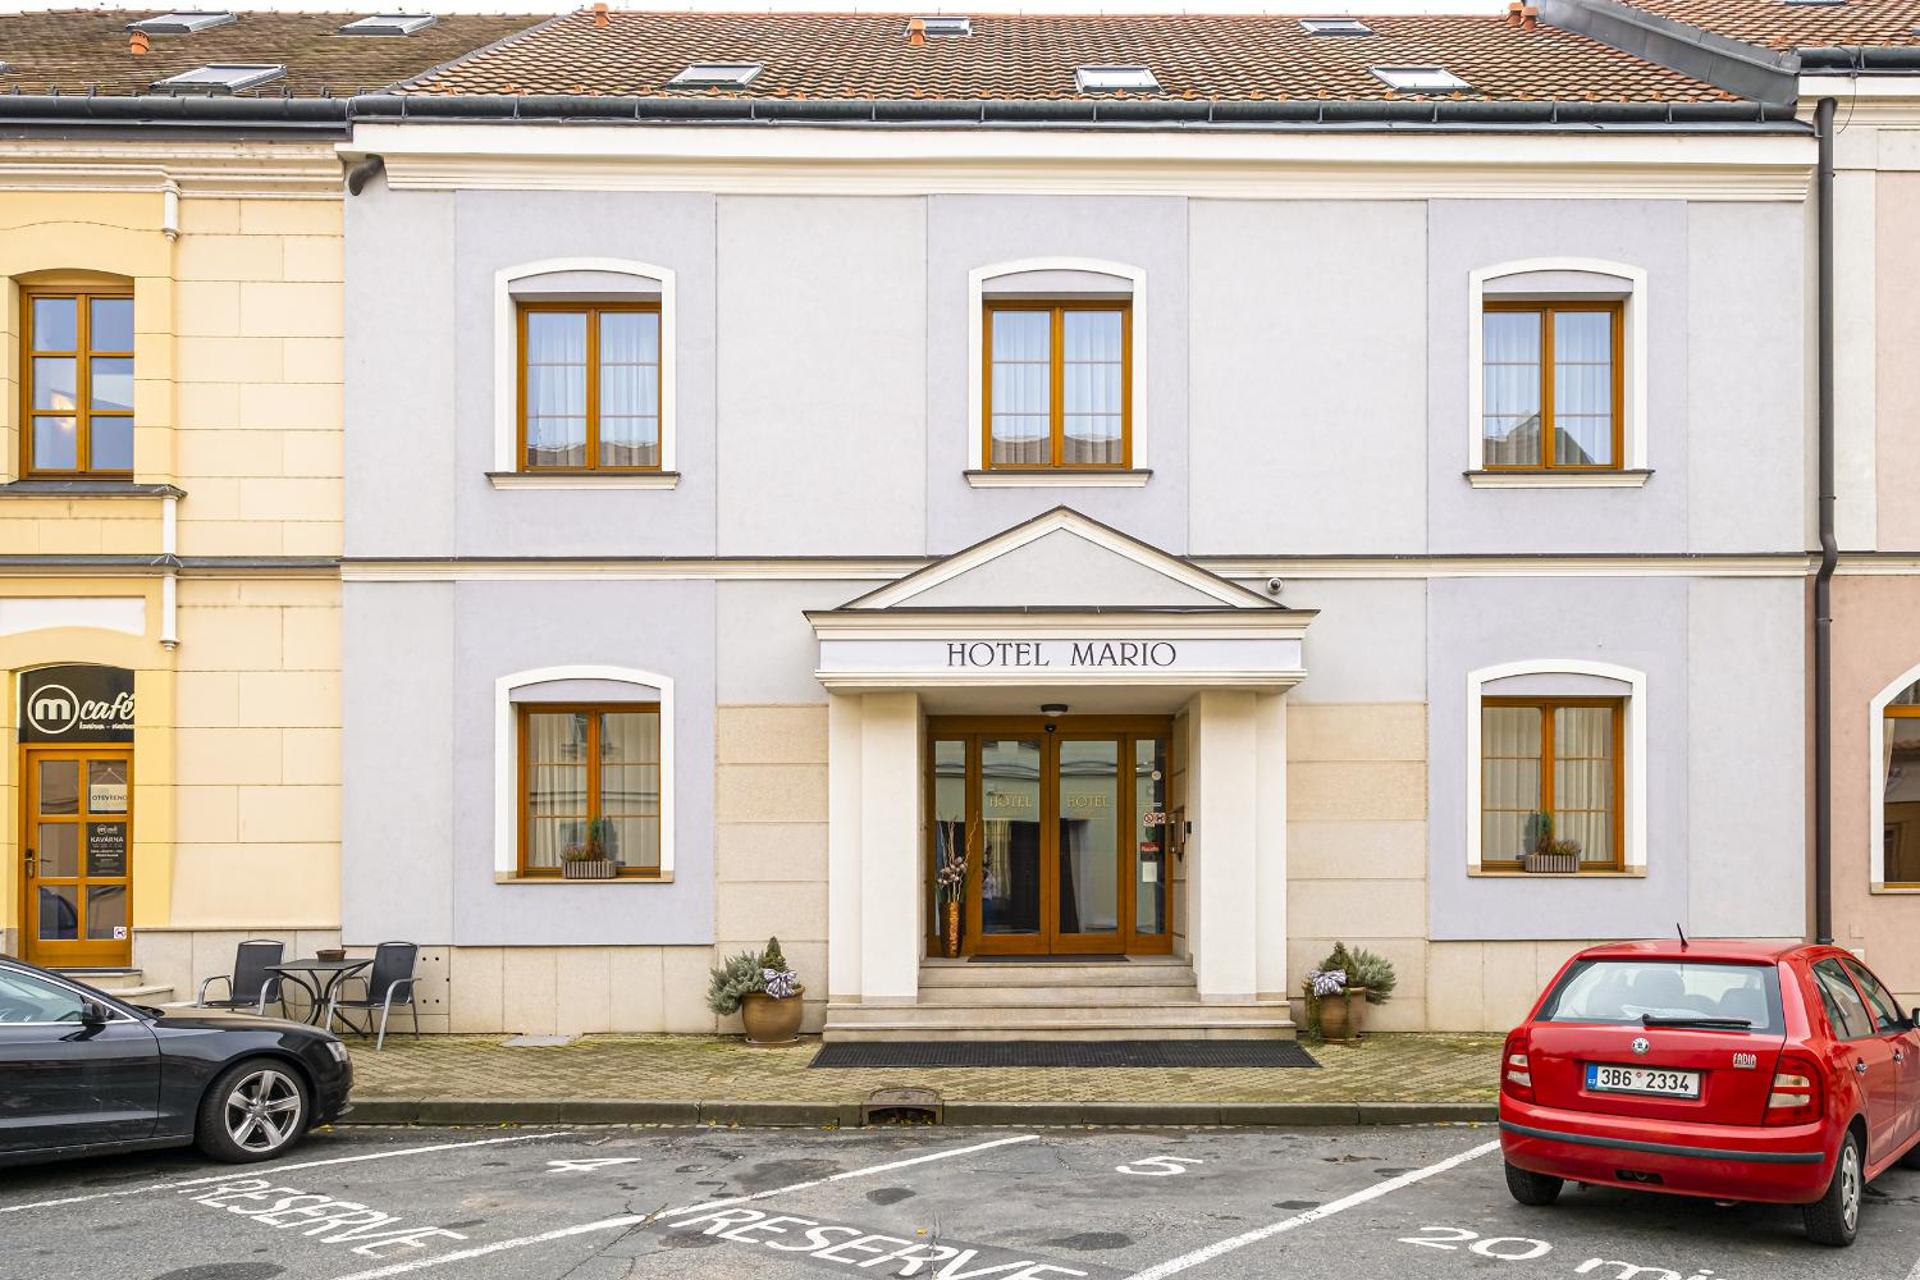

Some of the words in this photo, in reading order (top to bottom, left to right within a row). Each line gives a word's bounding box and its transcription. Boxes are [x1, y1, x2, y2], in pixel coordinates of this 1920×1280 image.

[947, 642, 1050, 667] HOTEL
[1070, 642, 1177, 667] MARIO
[80, 692, 134, 720] café
[1601, 1069, 1632, 1086] 3B6
[1646, 1072, 1689, 1092] 2334
[547, 1157, 641, 1173] 4
[1115, 1155, 1203, 1176] 5
[177, 1179, 469, 1258] RESERVE
[1398, 1227, 1553, 1260] 20
